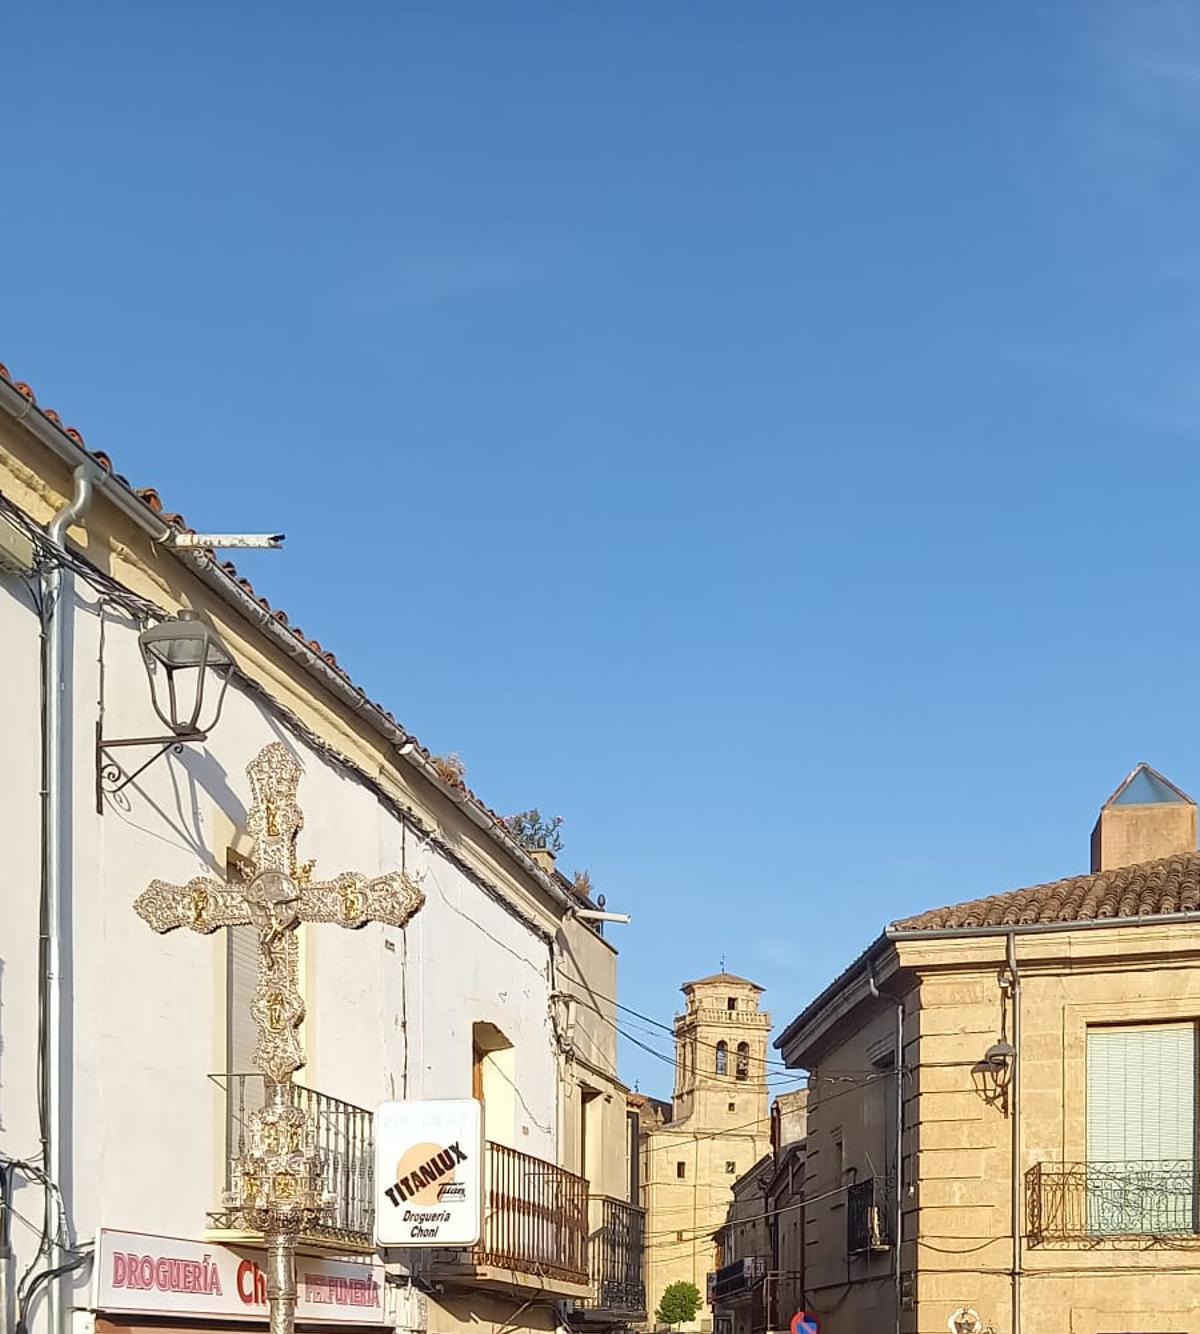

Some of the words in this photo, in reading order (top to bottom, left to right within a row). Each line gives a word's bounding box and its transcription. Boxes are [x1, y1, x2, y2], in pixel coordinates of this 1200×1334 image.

[384, 1141, 468, 1208] TITANLUX
[410, 1225, 439, 1238] Choni
[112, 1252, 223, 1297] DROGUERÍA
[304, 1273, 381, 1308] PERFUMERÍA
